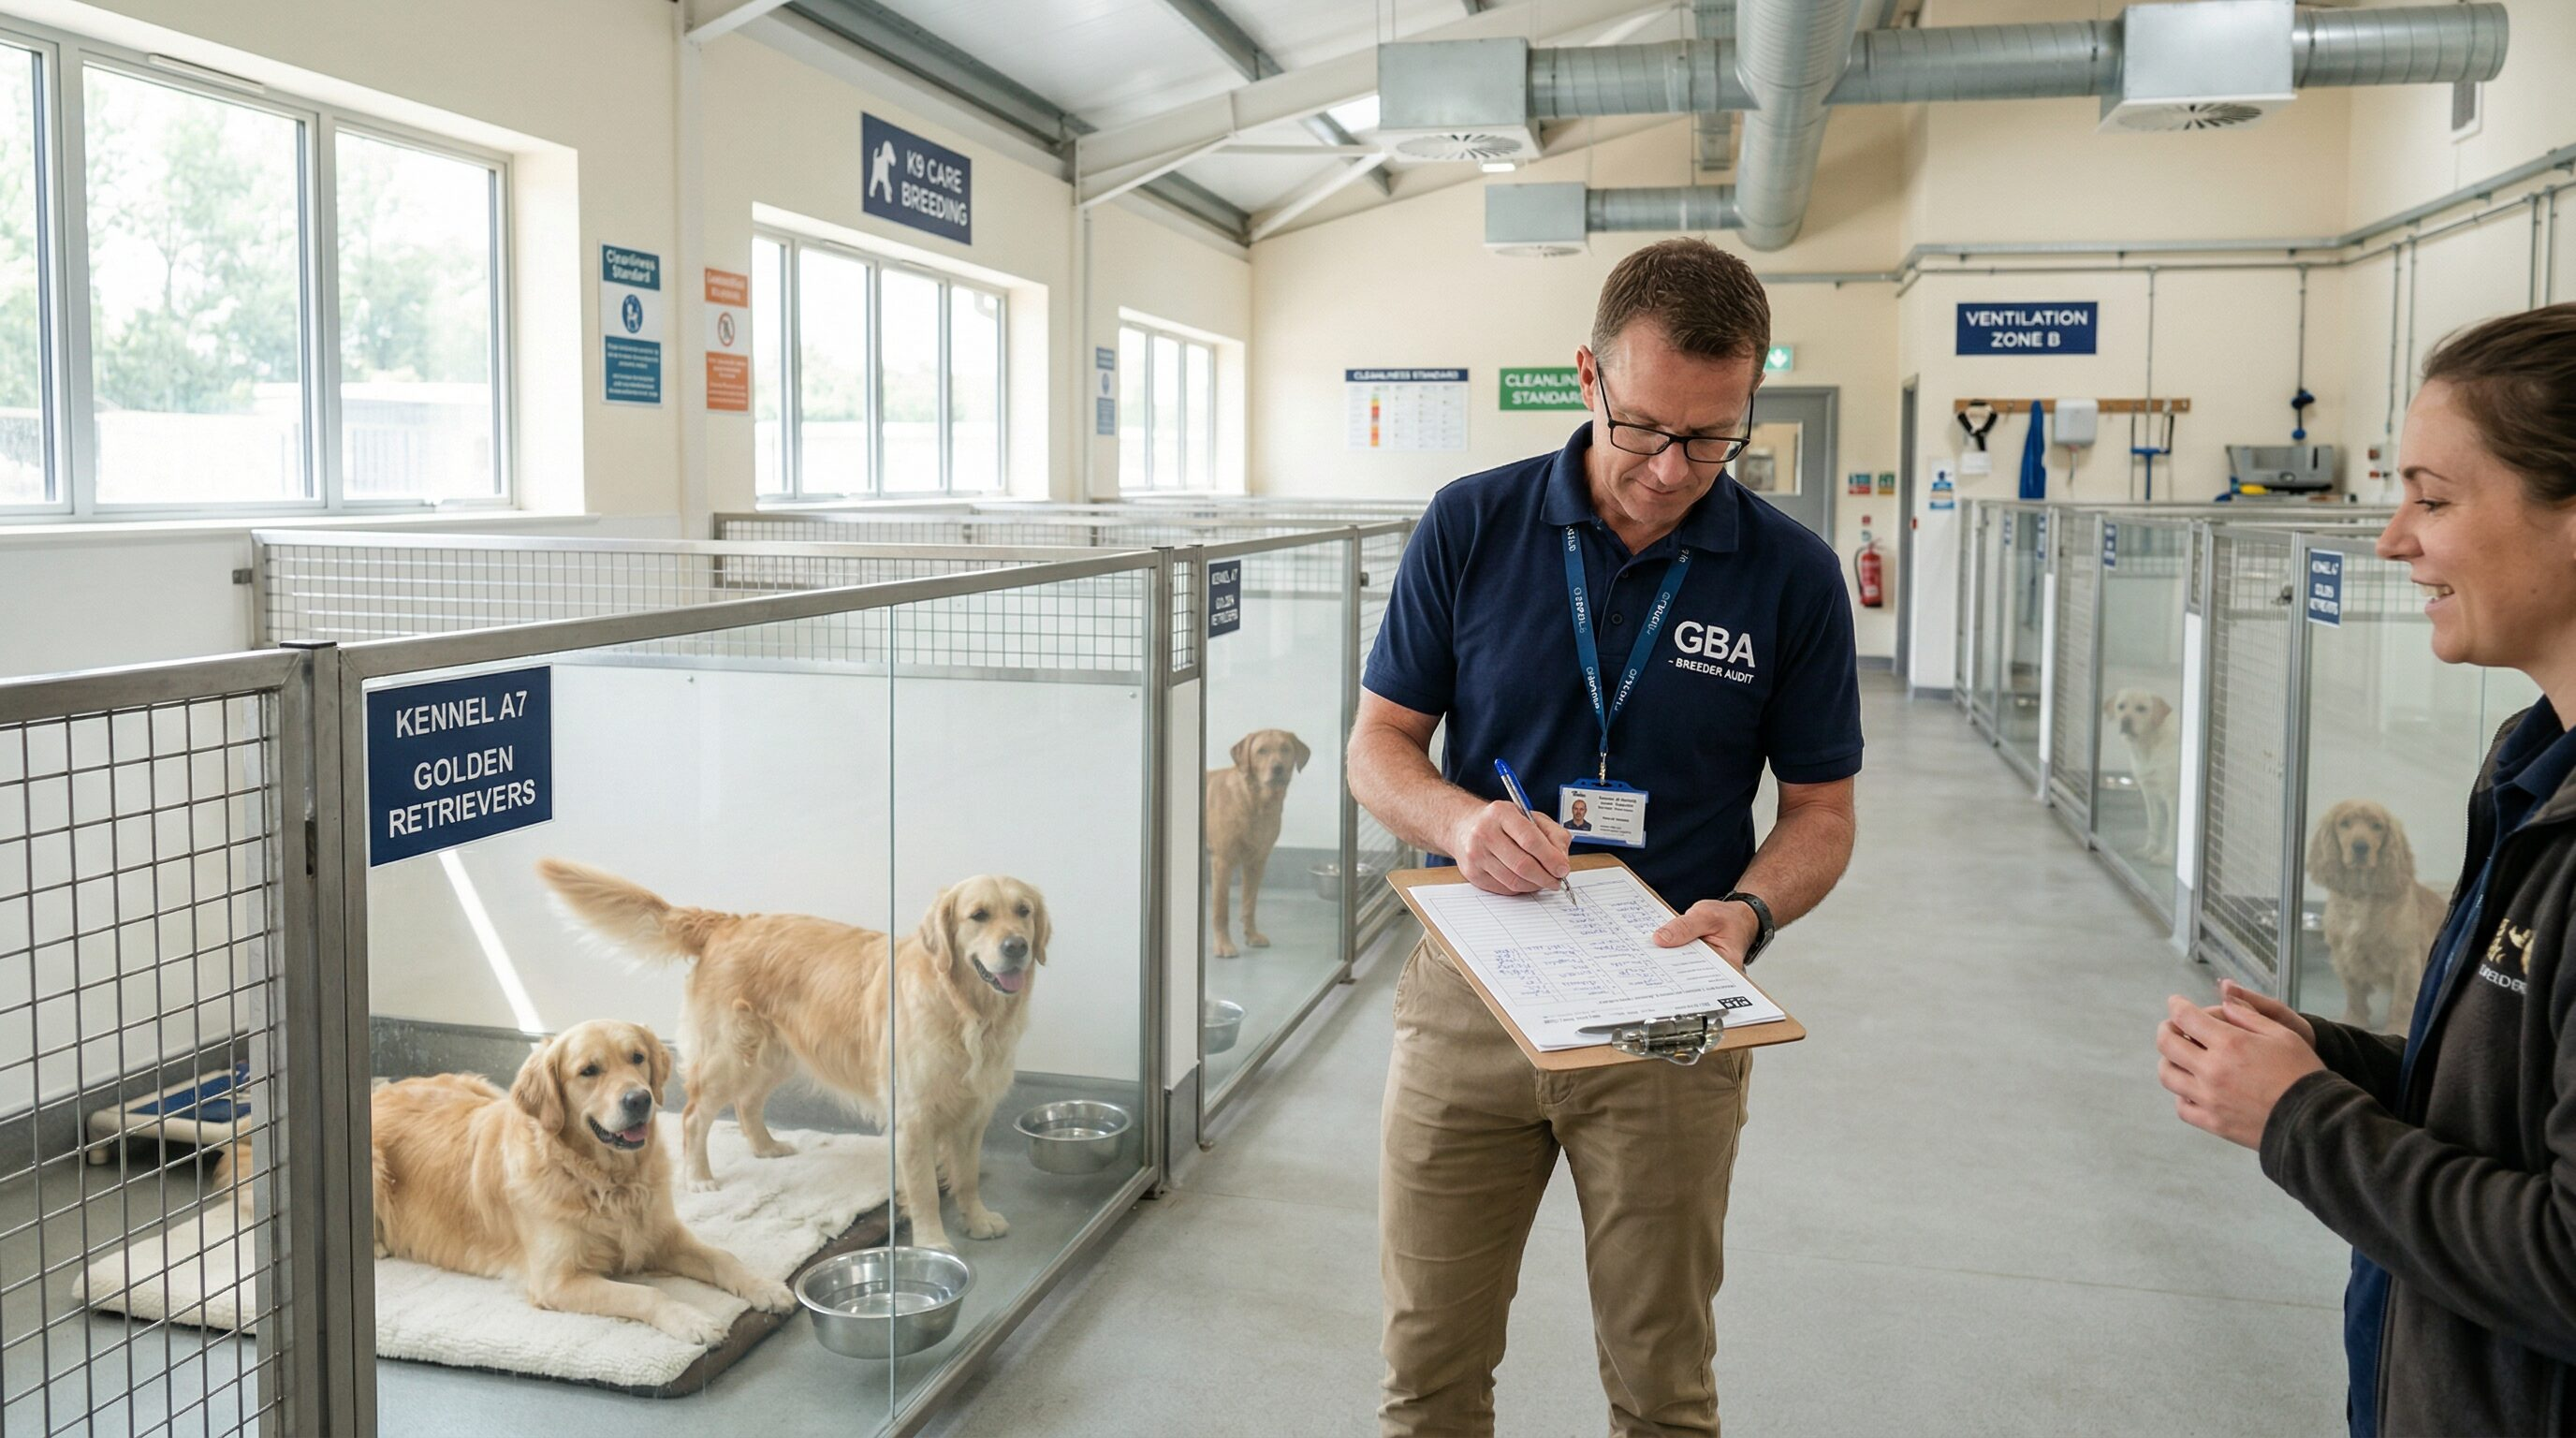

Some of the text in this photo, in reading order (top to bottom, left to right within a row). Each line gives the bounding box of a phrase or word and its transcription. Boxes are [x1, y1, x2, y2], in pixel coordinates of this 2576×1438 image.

[906, 150, 962, 194] K9 CARE
[901, 181, 968, 227] BREEDING
[1966, 310, 2088, 327] VENTILATION
[1990, 331, 2060, 347] ZONE B
[1512, 391, 1585, 404] STANDAR
[1674, 621, 1755, 668] GBA
[1676, 657, 1723, 677] BREEDER
[1724, 668, 1754, 684] AUDIT
[396, 690, 528, 738] KENNEL A7
[414, 745, 514, 790] GOLDEN
[388, 779, 536, 838] RETRIEVERS
